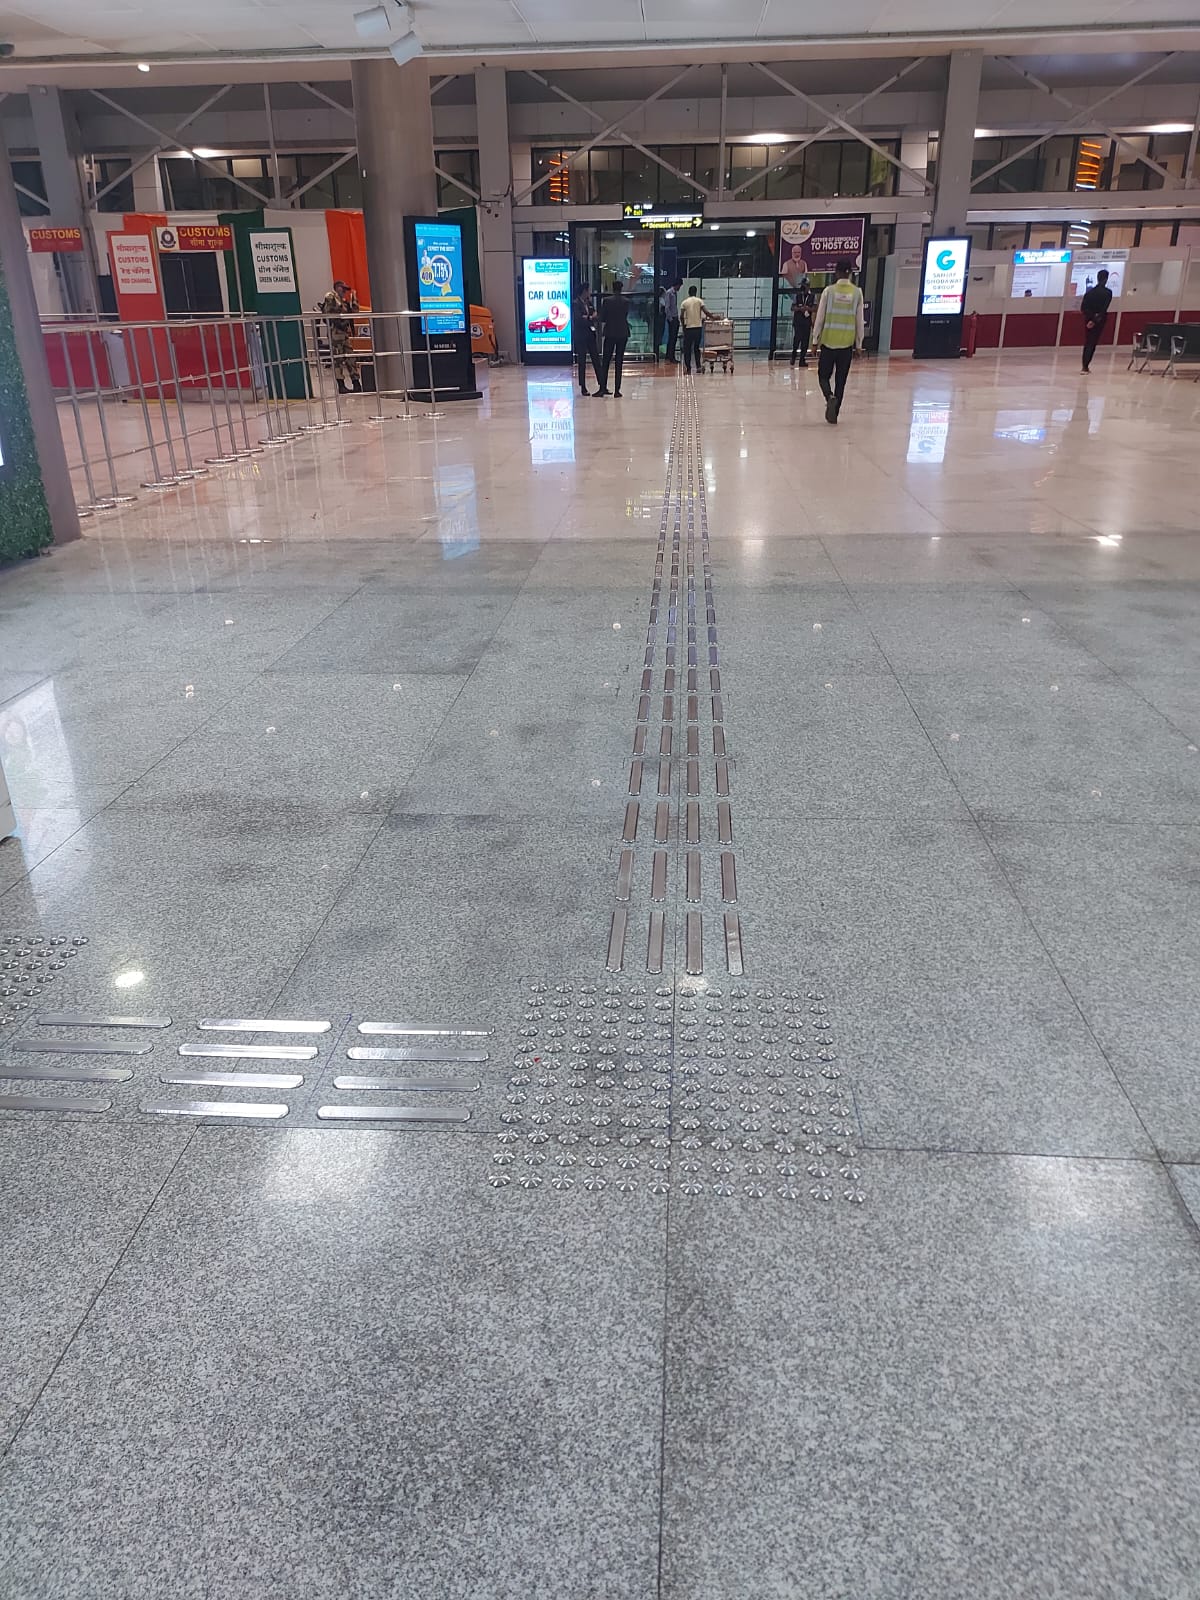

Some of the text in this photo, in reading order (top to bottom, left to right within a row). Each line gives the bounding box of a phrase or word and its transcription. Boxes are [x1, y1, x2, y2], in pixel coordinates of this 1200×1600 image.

[672, 221, 693, 229] Transfer
[31, 229, 81, 240] CUSTOMS
[180, 226, 231, 237] CUSTOMS
[811, 241, 859, 250] TO HOST G20
[118, 256, 149, 264] CUSTOMS
[256, 255, 289, 263] CUSTOMS
[528, 290, 568, 300] CAR LOAN
